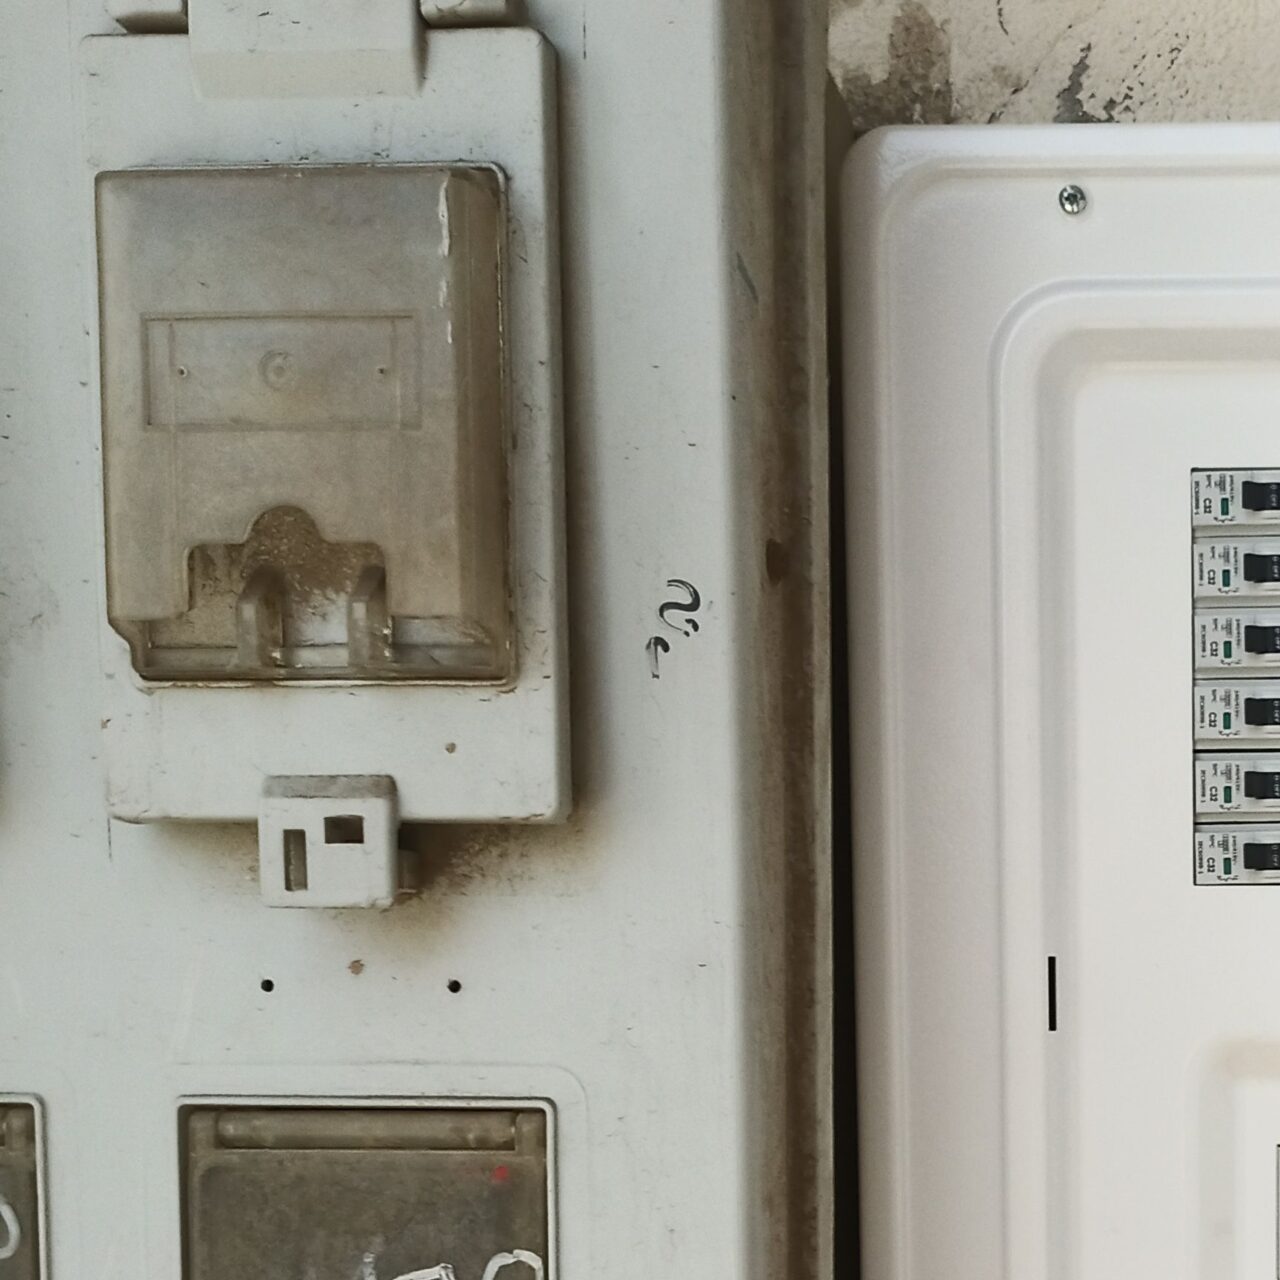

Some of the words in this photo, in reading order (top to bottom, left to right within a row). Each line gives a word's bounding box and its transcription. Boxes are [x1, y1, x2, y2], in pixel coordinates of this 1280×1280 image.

[1210, 641, 1218, 657] C32
[1209, 712, 1217, 727] C32
[1209, 786, 1217, 801] C32
[1207, 857, 1215, 873] C32
